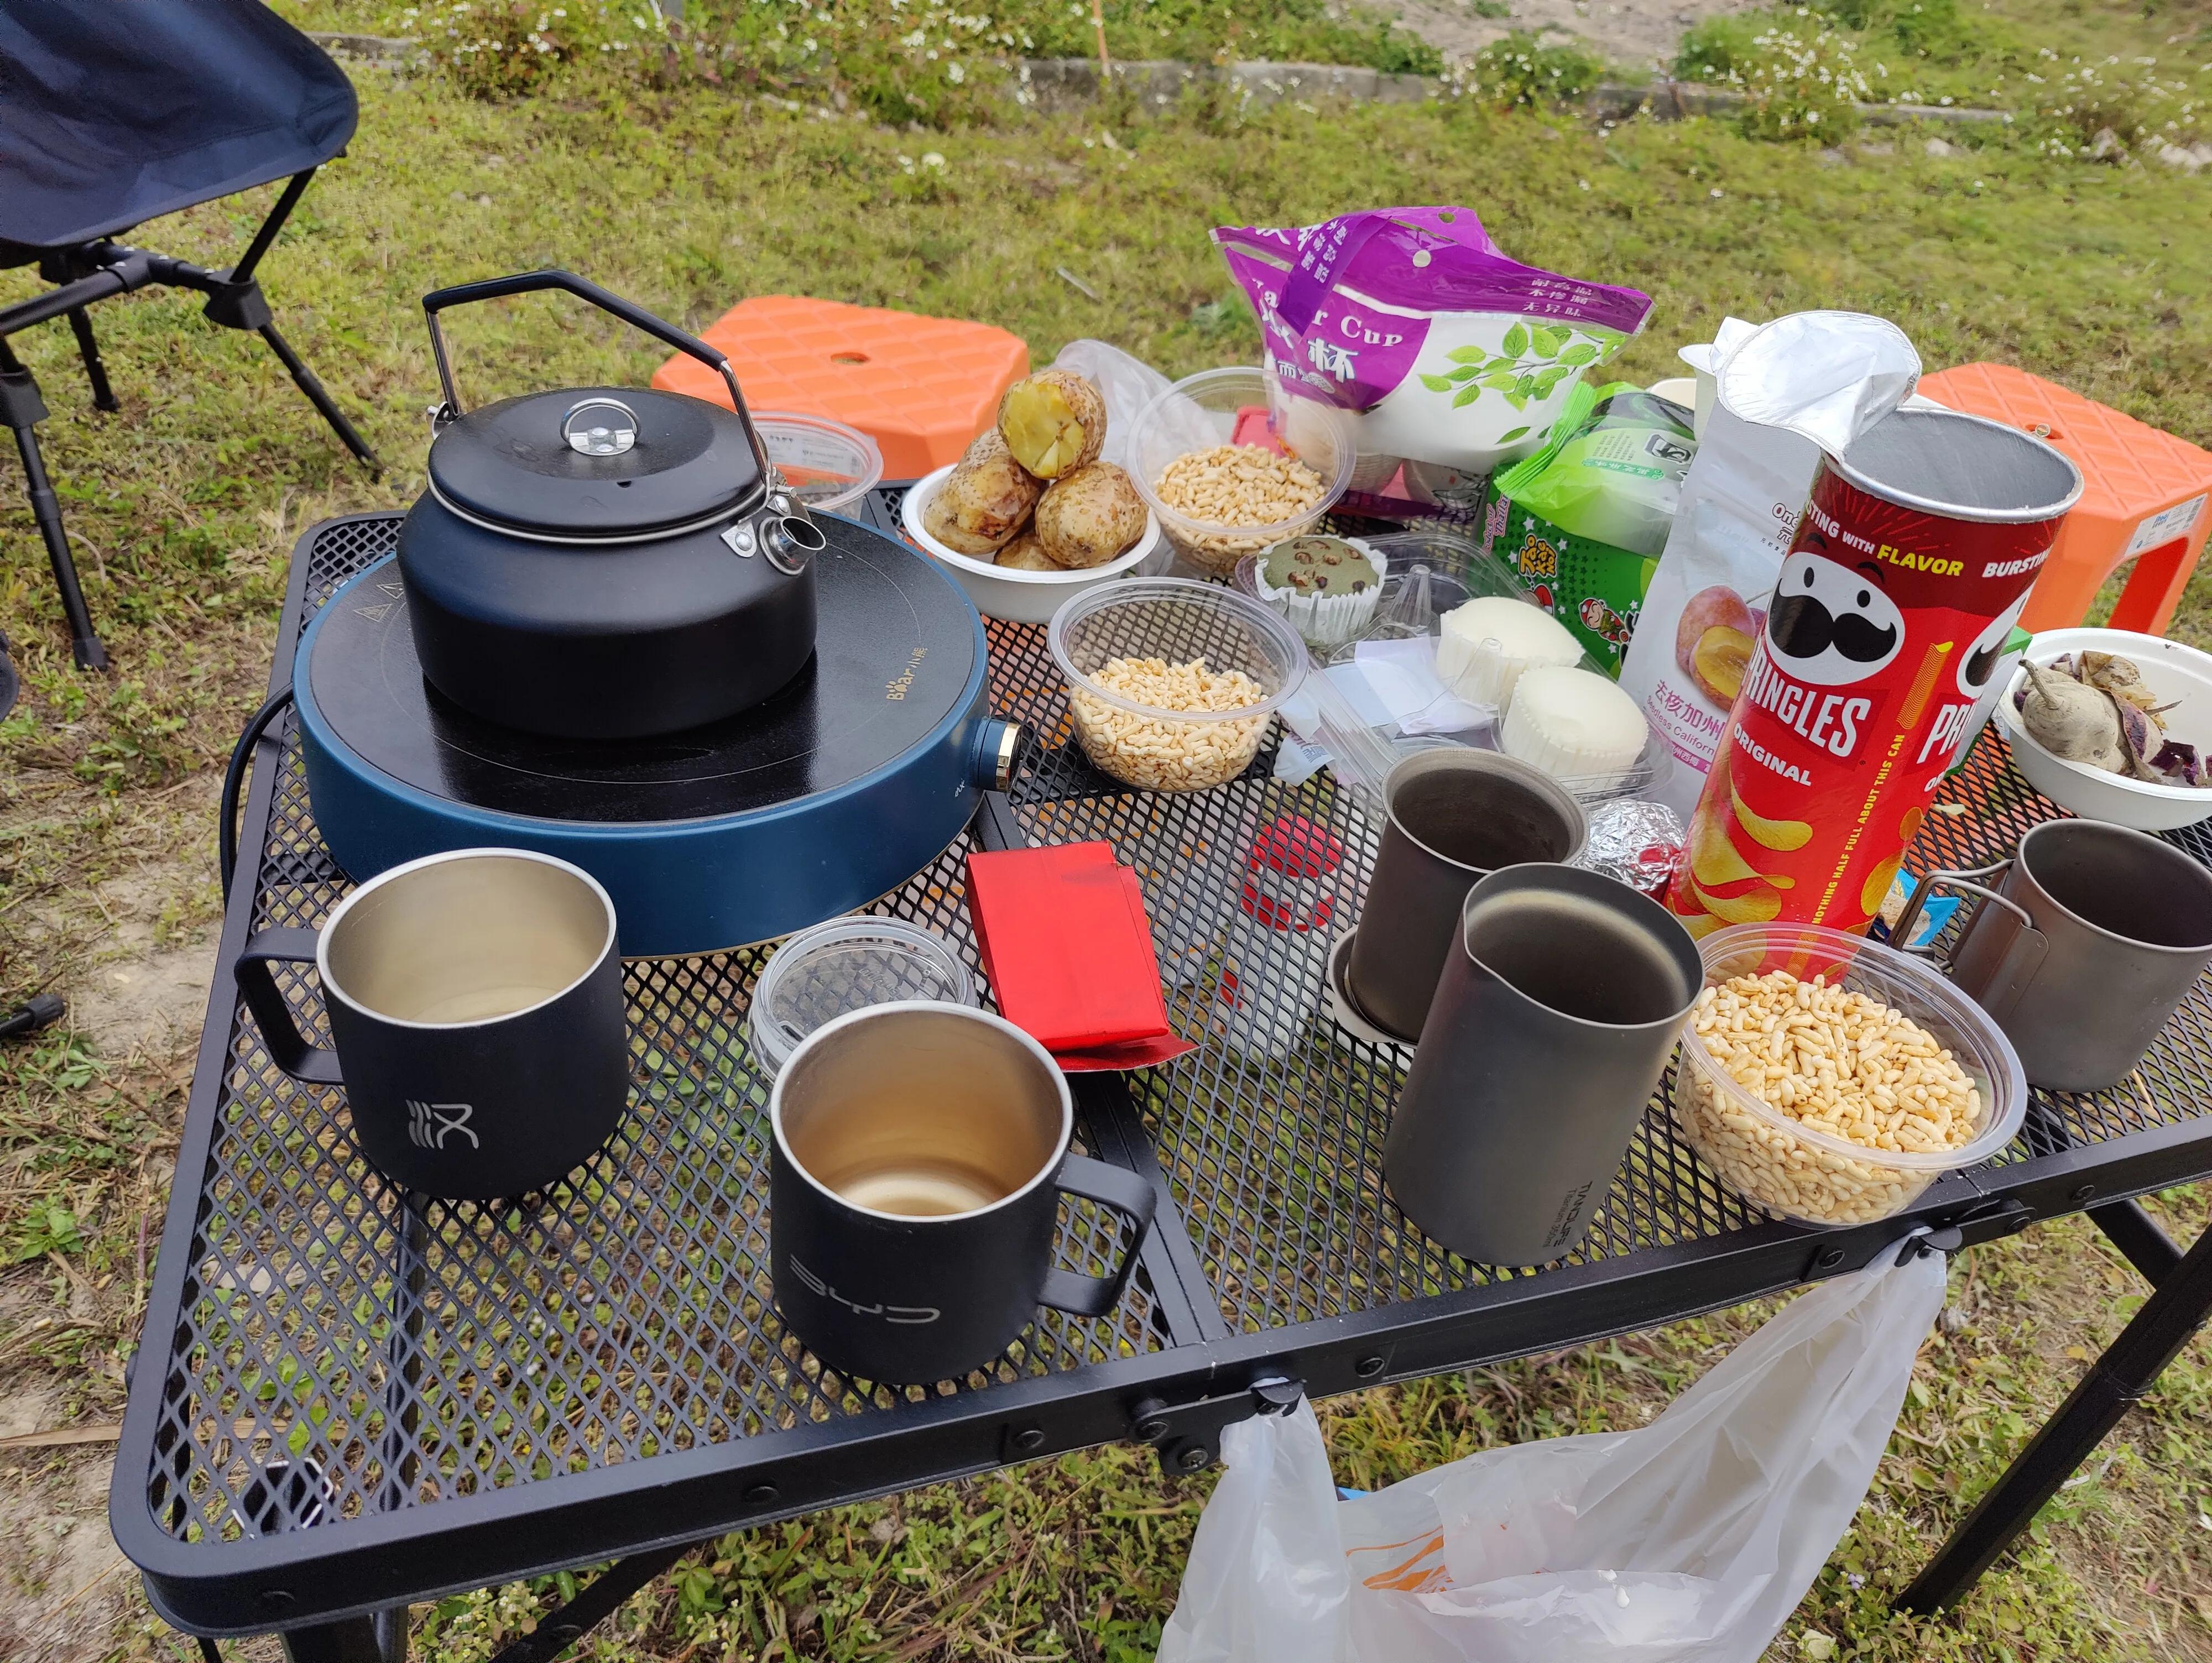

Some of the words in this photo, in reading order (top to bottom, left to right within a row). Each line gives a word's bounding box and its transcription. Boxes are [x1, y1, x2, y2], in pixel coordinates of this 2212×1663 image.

[1522, 301, 1592, 317] 无异味
[1341, 316, 1402, 347] Cup
[1520, 535, 1536, 574] Tao
[1806, 499, 1840, 538] STING
[1842, 531, 1875, 555] WITH
[1877, 544, 1964, 577] FLAVOR
[1536, 541, 1547, 576] Kae
[1982, 544, 2053, 578] BURSTIN
[1647, 695, 1672, 730] Seedless
[1673, 726, 1714, 756] Californ
[1734, 722, 1812, 787] ORIGINAL
[1812, 881, 1839, 924] NOTHING
[1832, 853, 1850, 878] HALF
[1844, 827, 1863, 850] FULL
[1857, 788, 1880, 824] ABOUT
[1874, 760, 1892, 786] THIS
[1887, 734, 1905, 757] CAN
